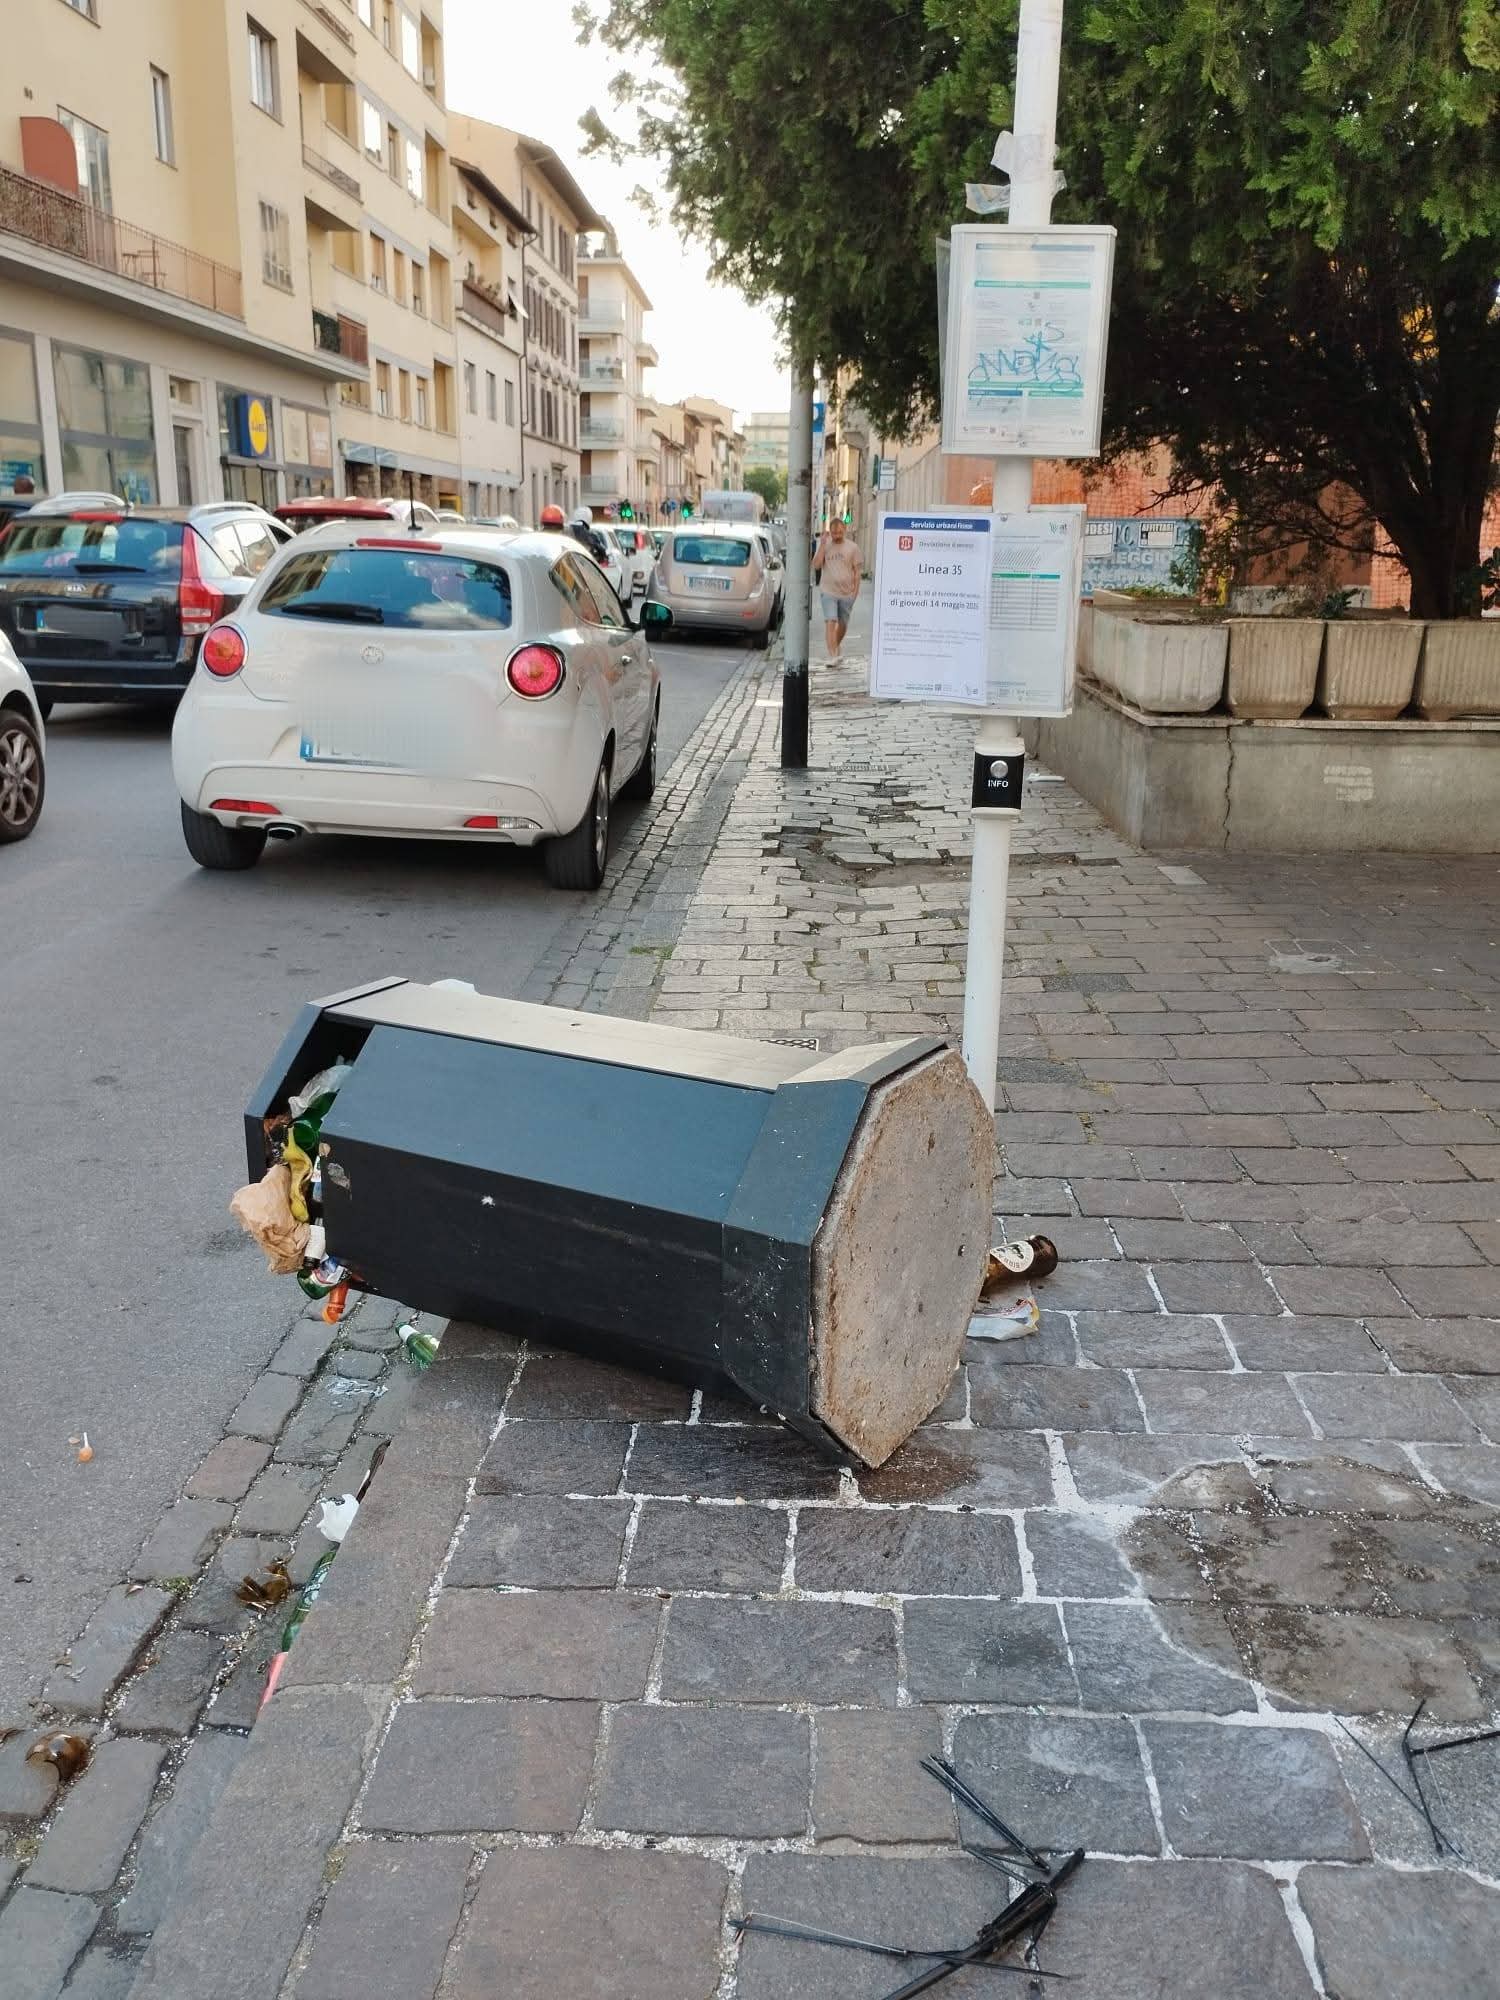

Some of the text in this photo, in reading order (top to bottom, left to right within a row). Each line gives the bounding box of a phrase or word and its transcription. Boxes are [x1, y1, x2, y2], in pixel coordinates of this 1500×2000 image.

[918, 563, 962, 575] Linea 35
[987, 779, 1009, 788] INFO
